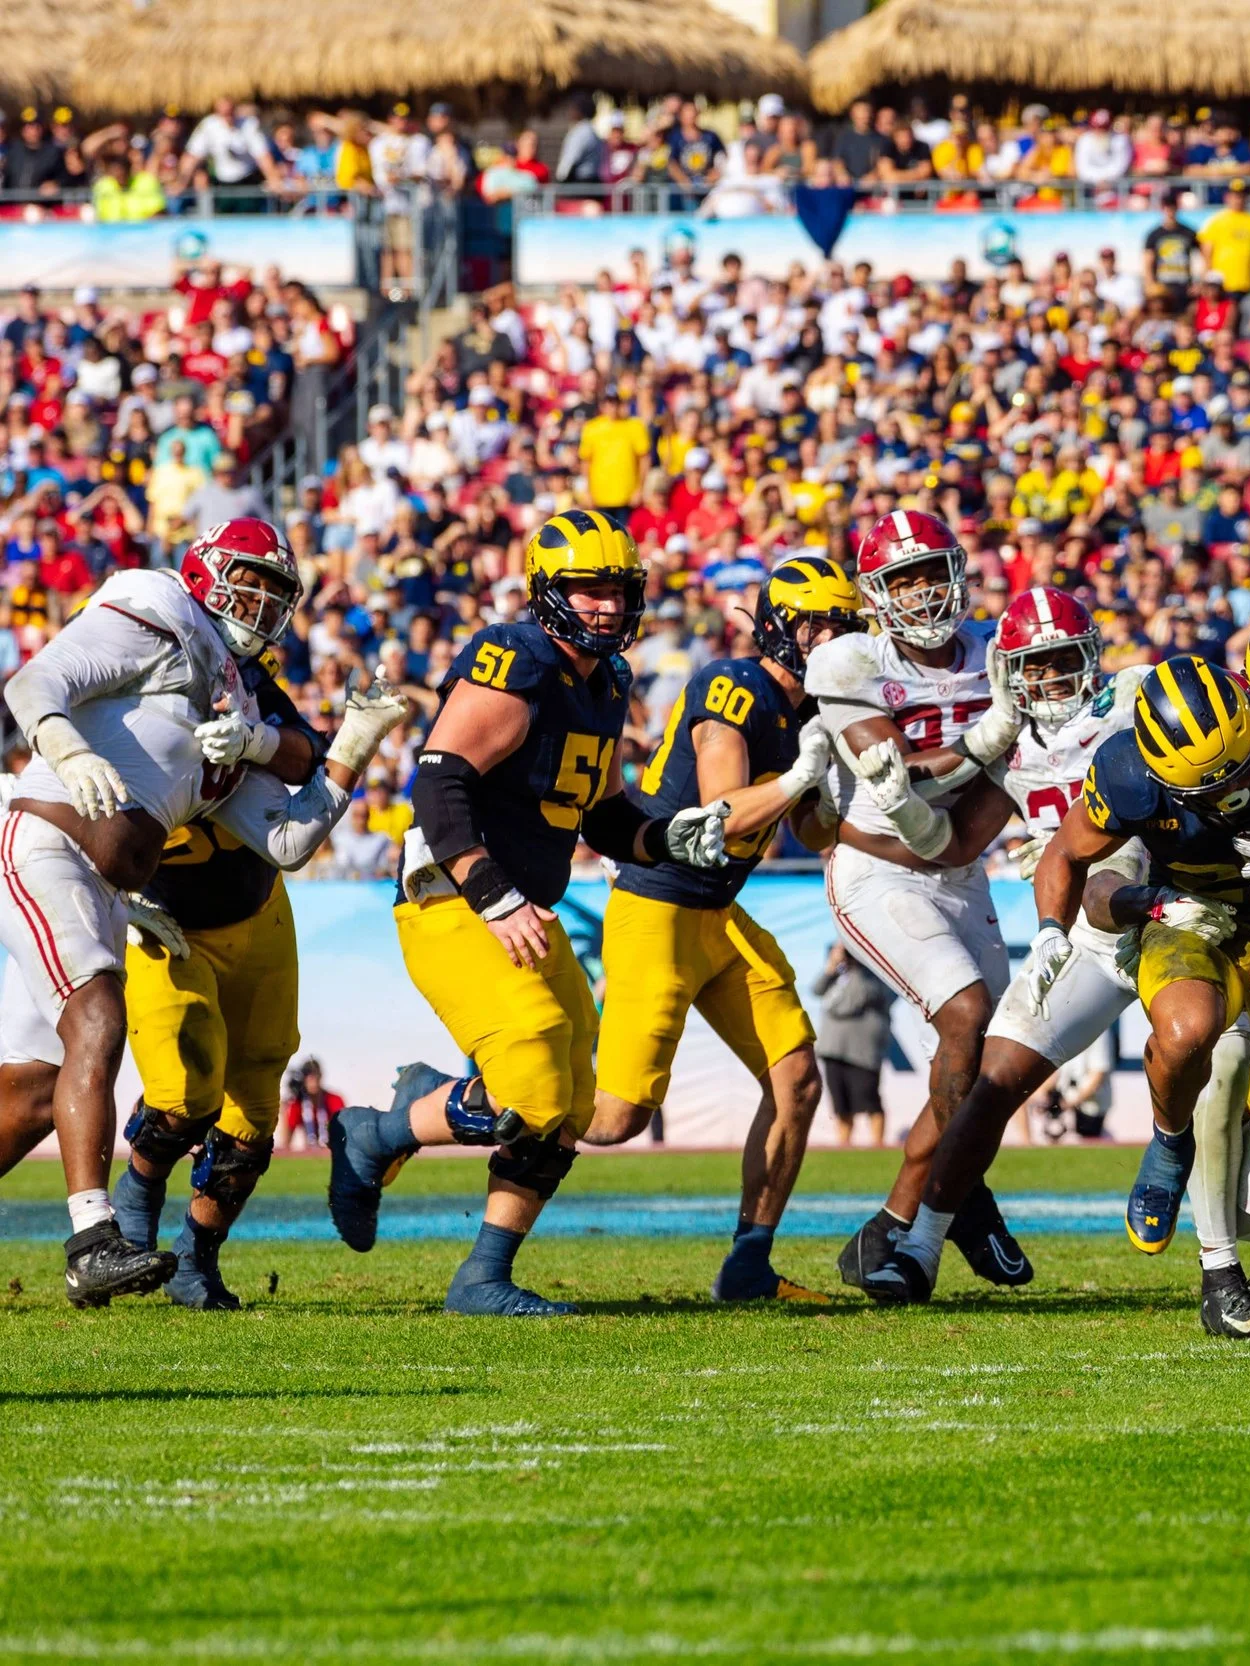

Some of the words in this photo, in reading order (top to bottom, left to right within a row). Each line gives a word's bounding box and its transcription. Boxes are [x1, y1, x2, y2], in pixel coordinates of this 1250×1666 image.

[471, 641, 517, 690] 51
[705, 675, 755, 726] 80
[540, 731, 615, 830] 51
[1145, 1216, 1159, 1227] M
